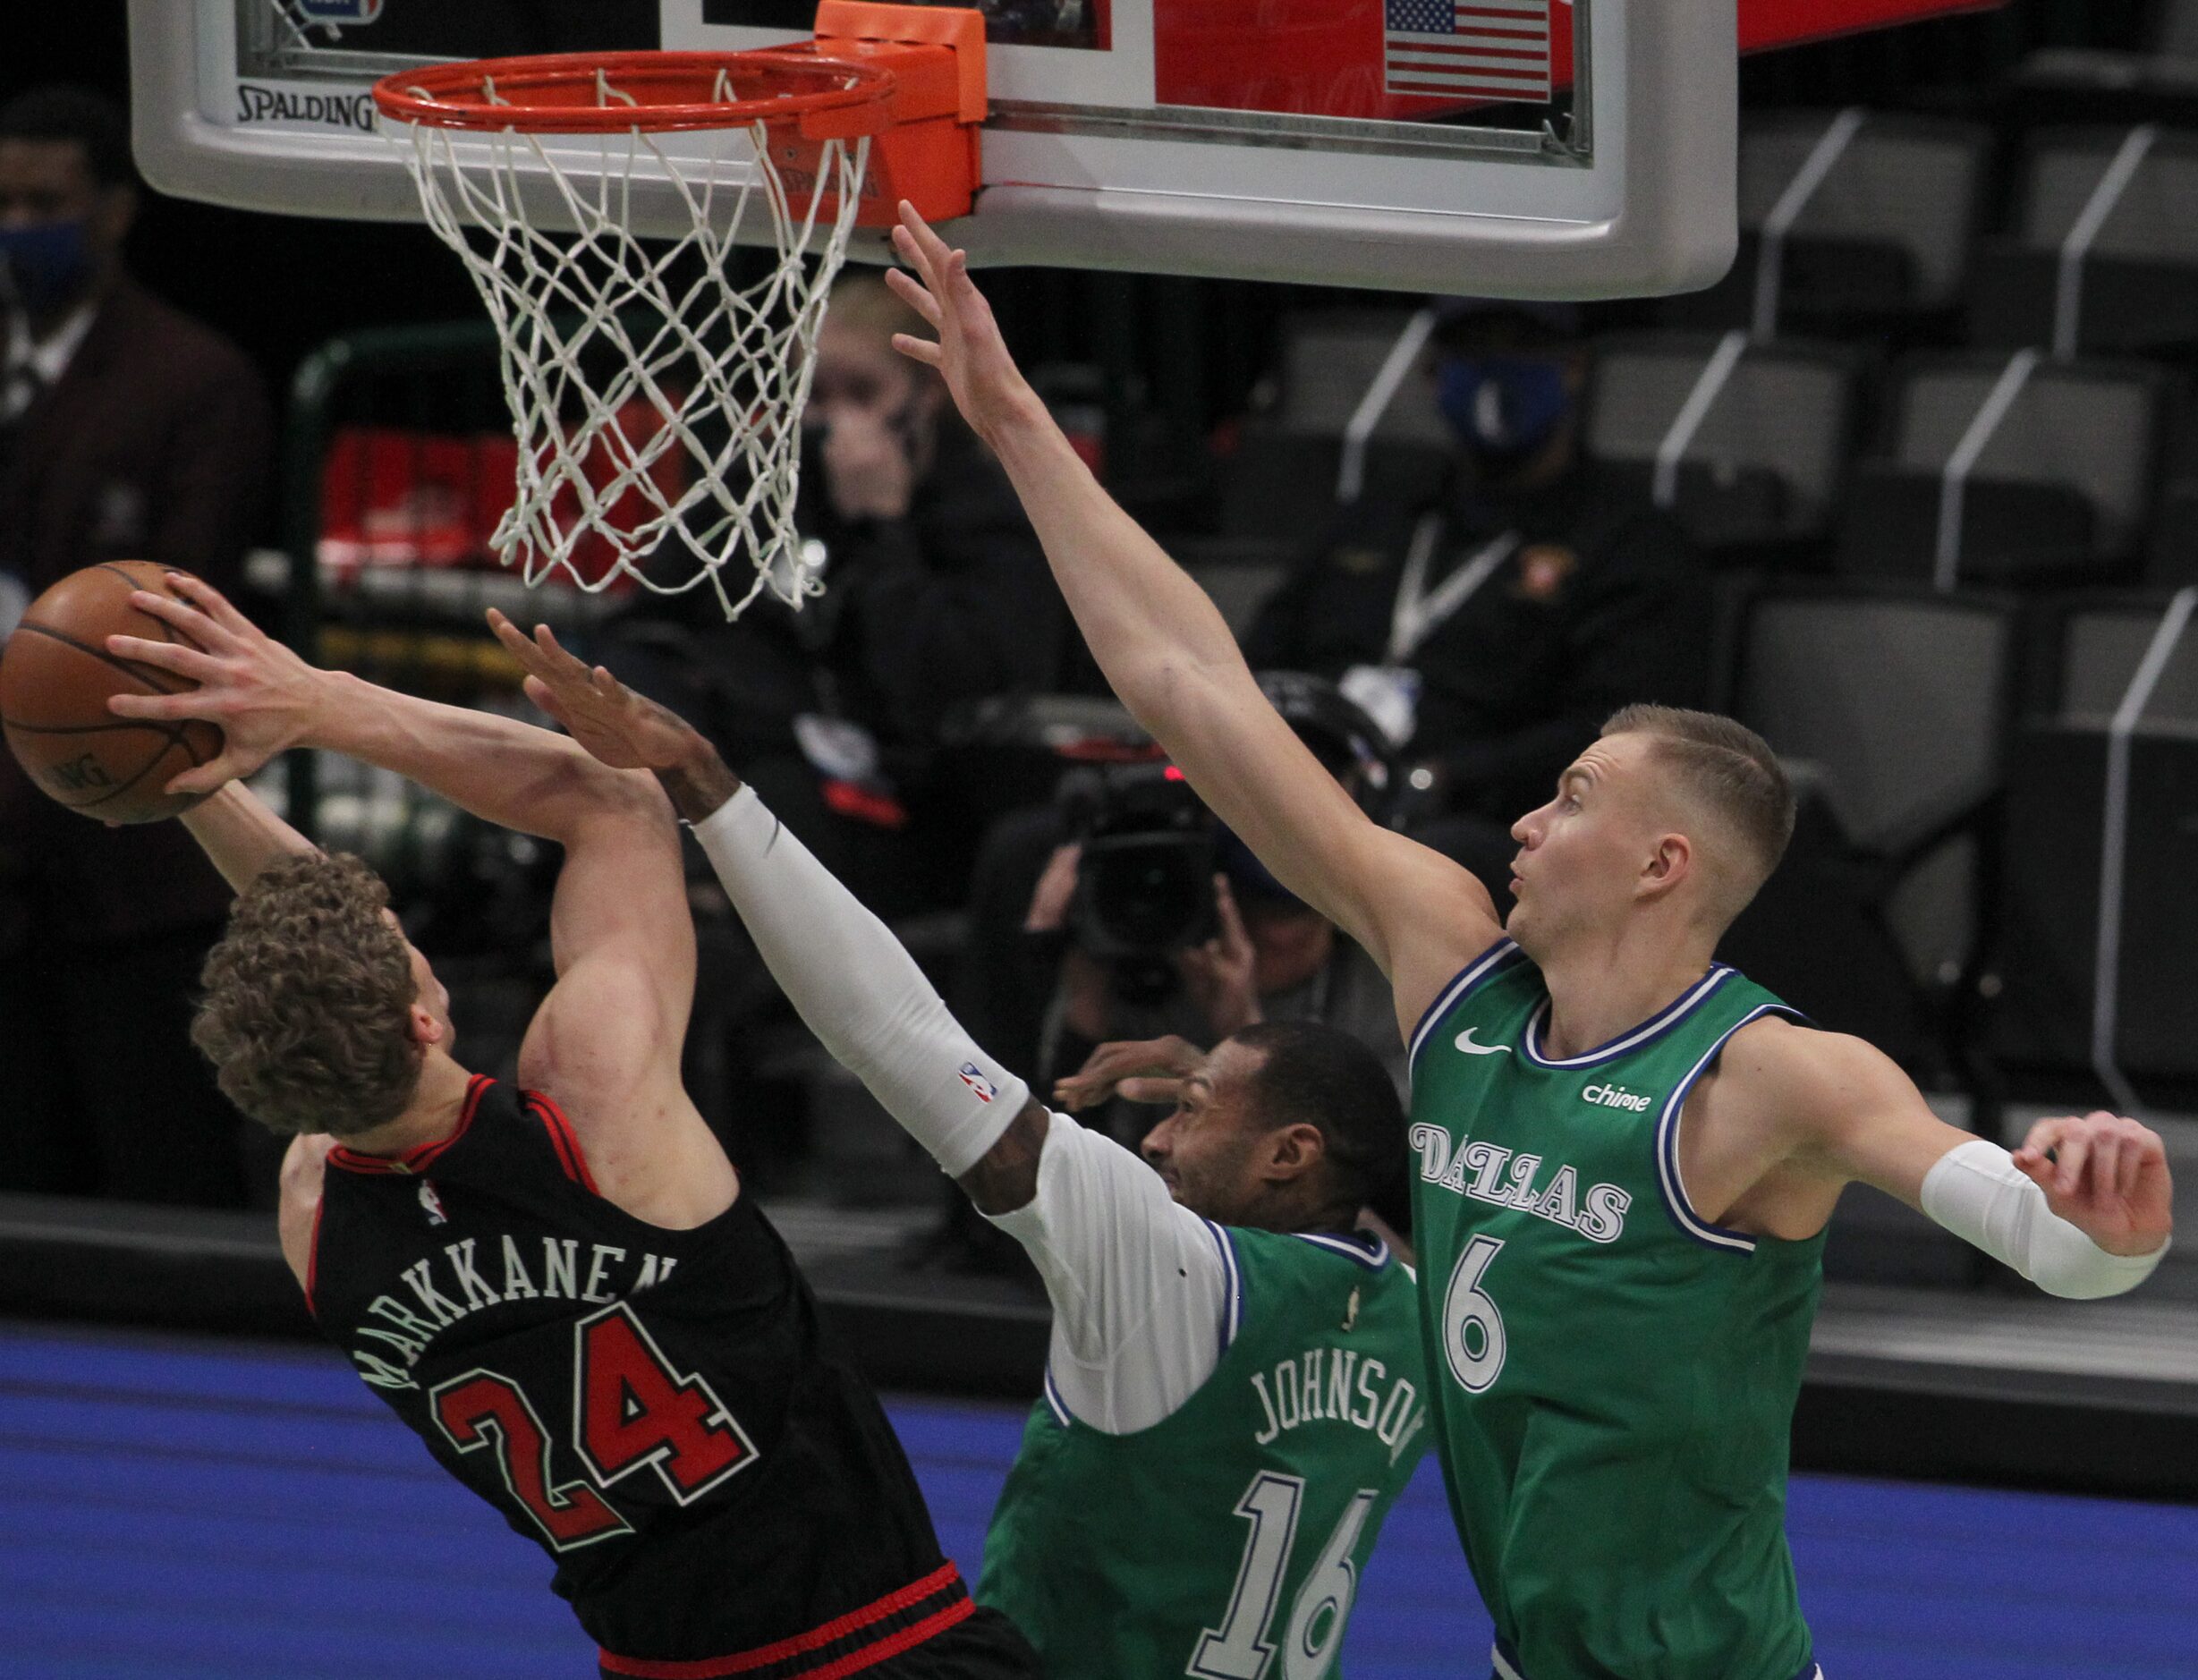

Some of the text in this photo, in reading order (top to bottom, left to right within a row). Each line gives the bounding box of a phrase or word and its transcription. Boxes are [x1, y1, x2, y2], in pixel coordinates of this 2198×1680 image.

[237, 85, 374, 132] SPALDING
[1582, 1084, 1651, 1112] chime
[1408, 1122, 1634, 1243] DALLAS
[1441, 1234, 1507, 1394] 6
[429, 1300, 760, 1553] 24
[1184, 1469, 1379, 1680] 16
